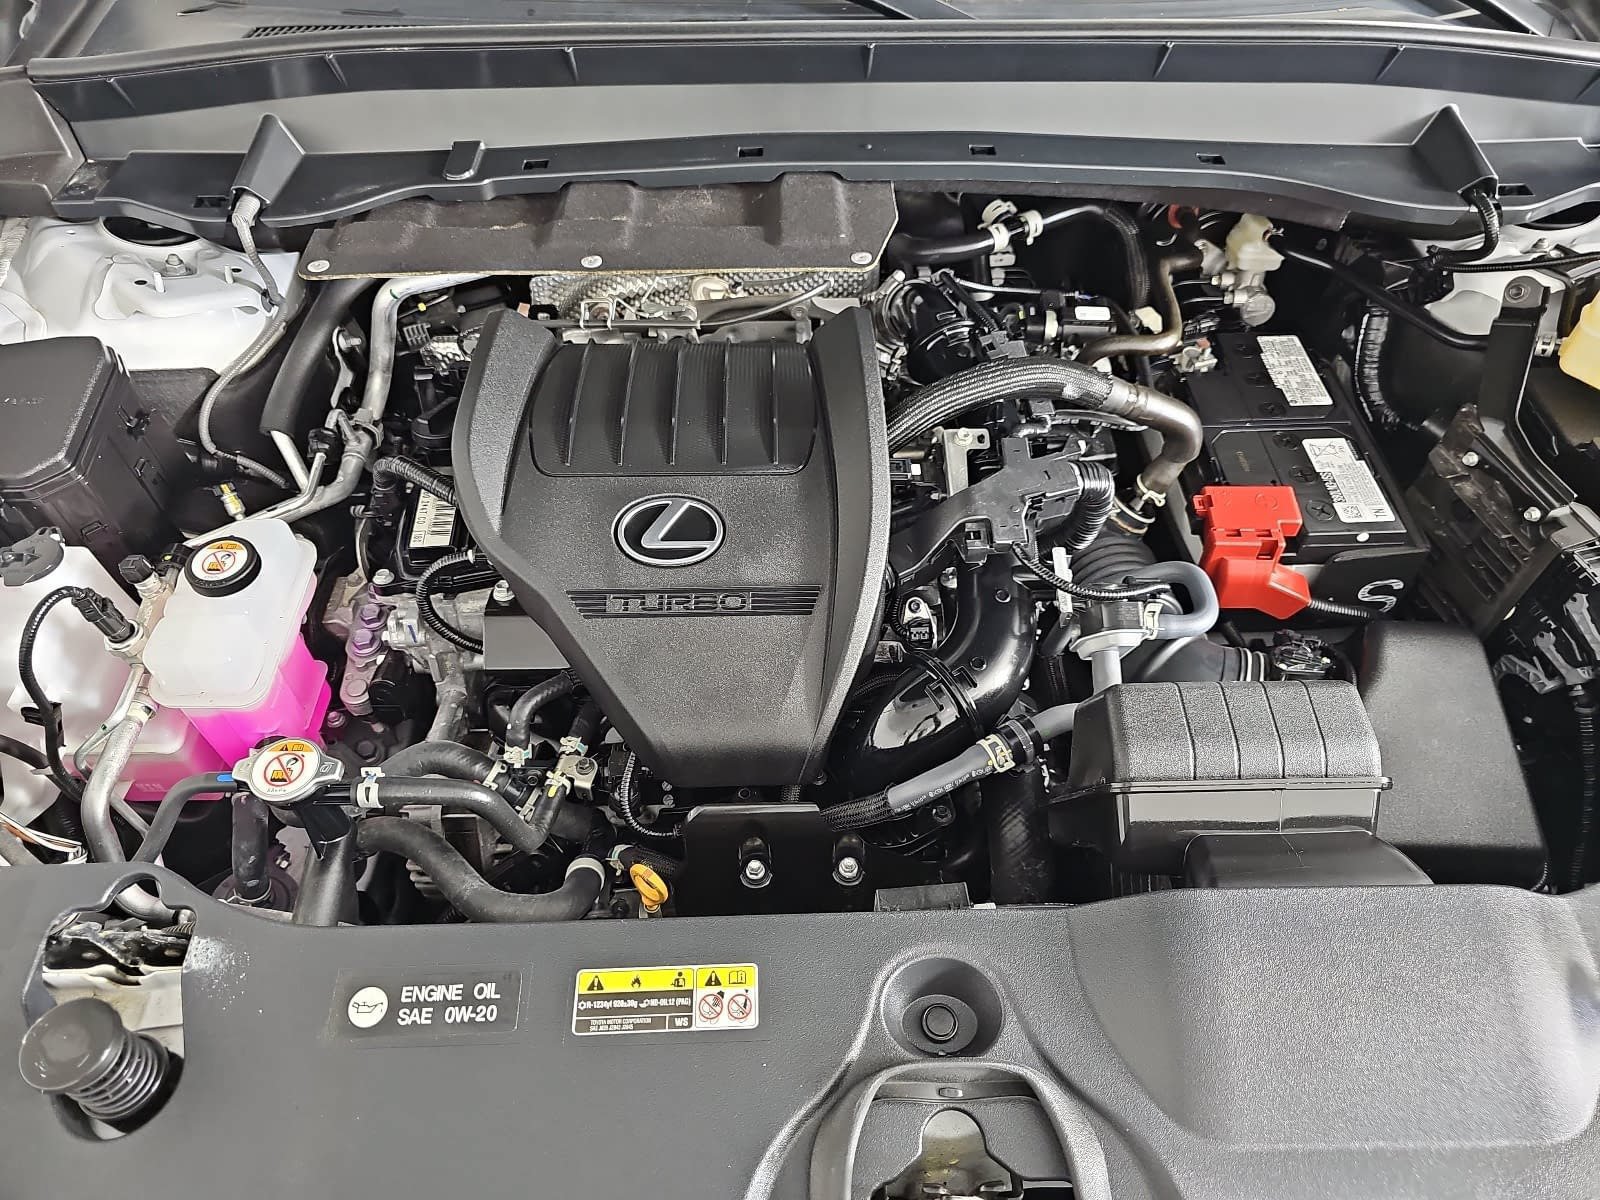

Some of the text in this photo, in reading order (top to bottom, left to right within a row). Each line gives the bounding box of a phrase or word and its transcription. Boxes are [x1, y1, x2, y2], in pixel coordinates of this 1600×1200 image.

[606, 592, 749, 612] TURBO
[401, 982, 500, 1002] ENGINE OIL
[397, 1004, 497, 1025] SAE 0W-20
[674, 1017, 689, 1027] WS
